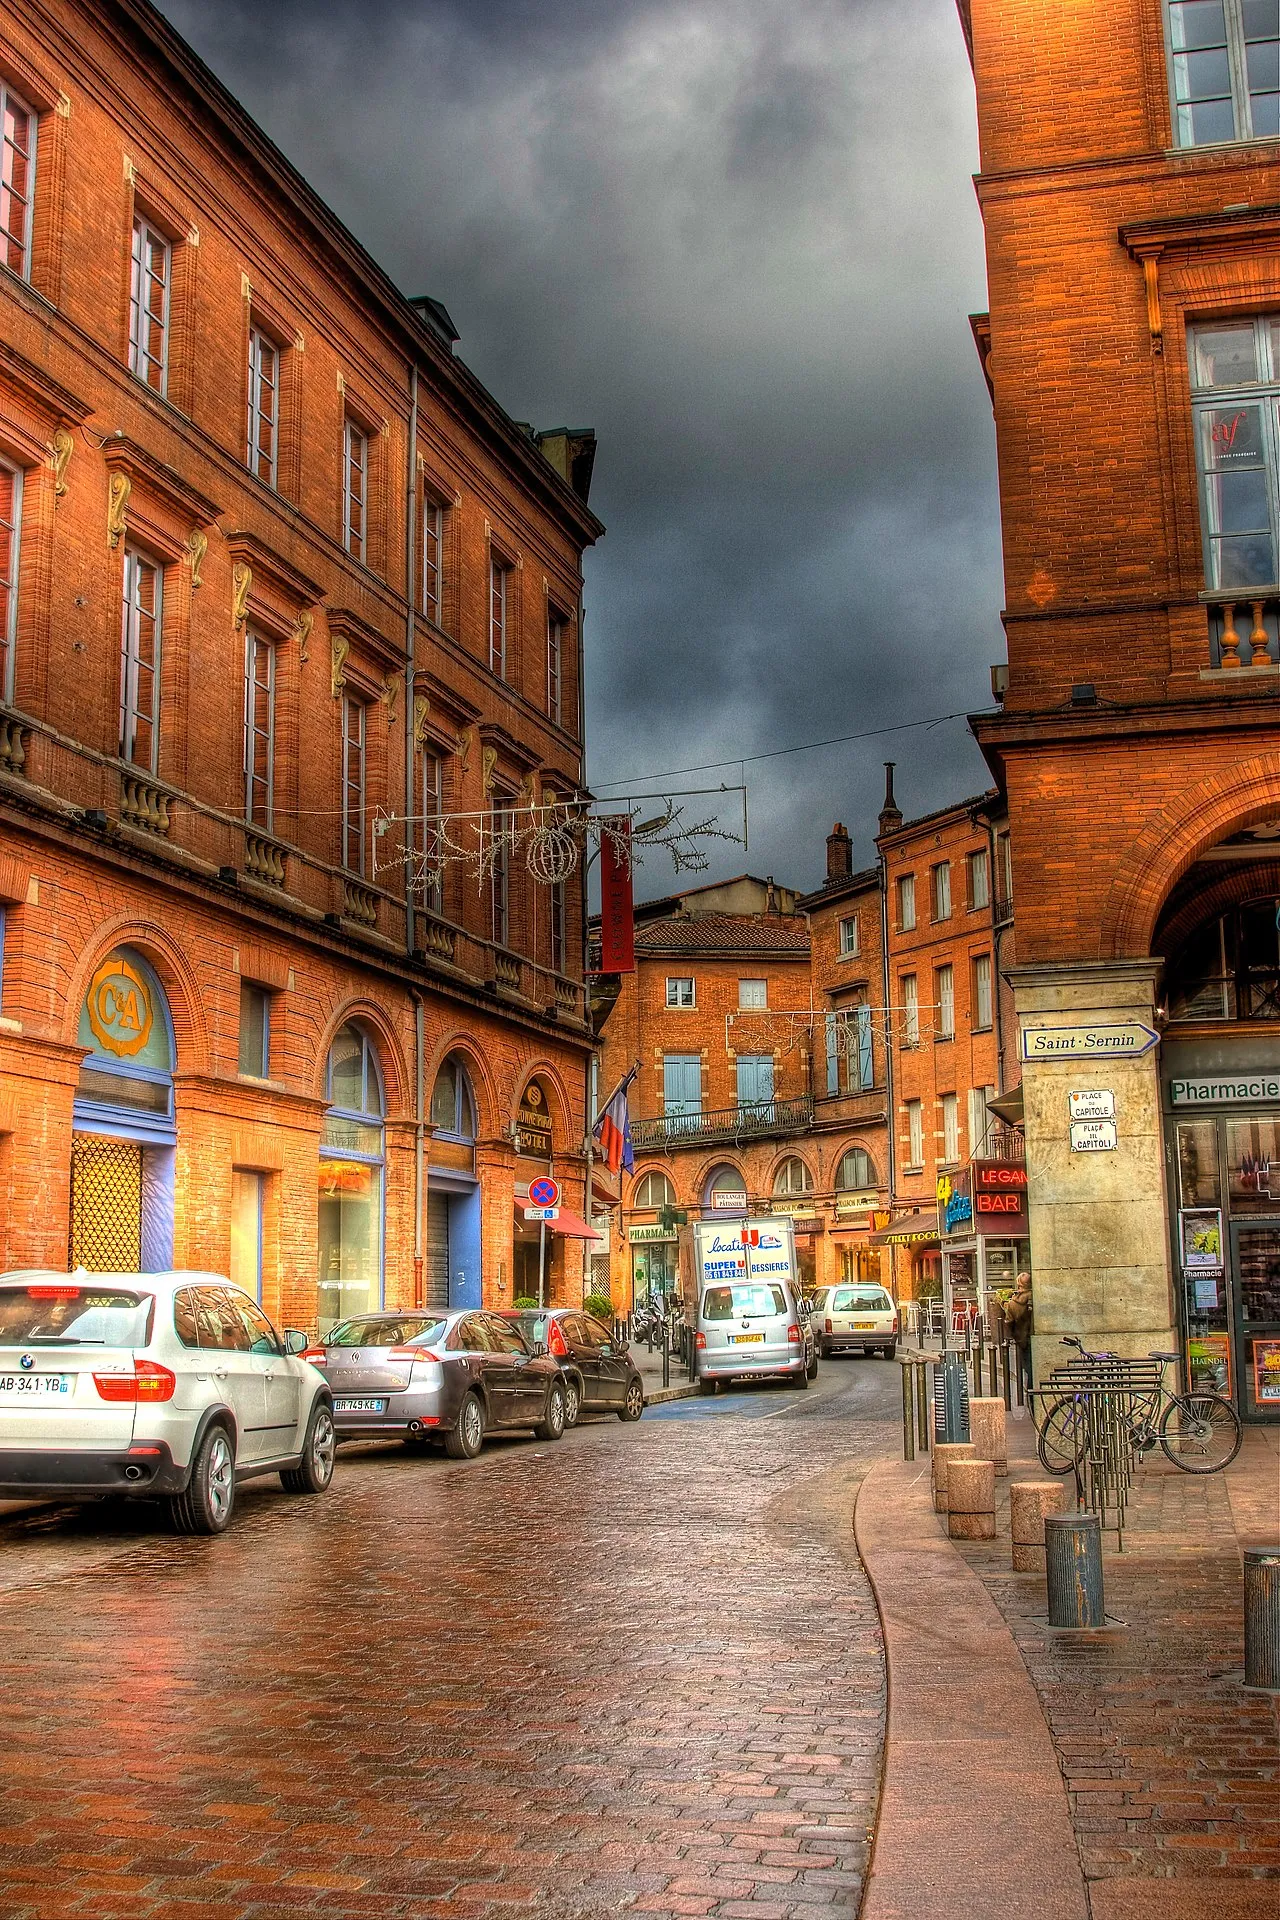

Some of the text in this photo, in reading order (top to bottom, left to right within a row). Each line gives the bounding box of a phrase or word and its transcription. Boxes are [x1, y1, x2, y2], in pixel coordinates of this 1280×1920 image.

[98, 983, 142, 1031] C&A
[1172, 1078, 1279, 1100] Pharmacie
[1081, 1092, 1102, 1100] PLACE
[1075, 1106, 1109, 1117] CAPITOLE
[1077, 1139, 1111, 1149] CAPITOLI
[979, 1195, 1018, 1212] BAR
[629, 1228, 677, 1240] PHARMACIE
[911, 1231, 939, 1242] FOOD
[707, 1236, 757, 1253] location
[704, 1260, 745, 1270] SUPER U
[751, 1261, 789, 1273] BESSIERES
[1183, 1270, 1222, 1278] Pharmacie
